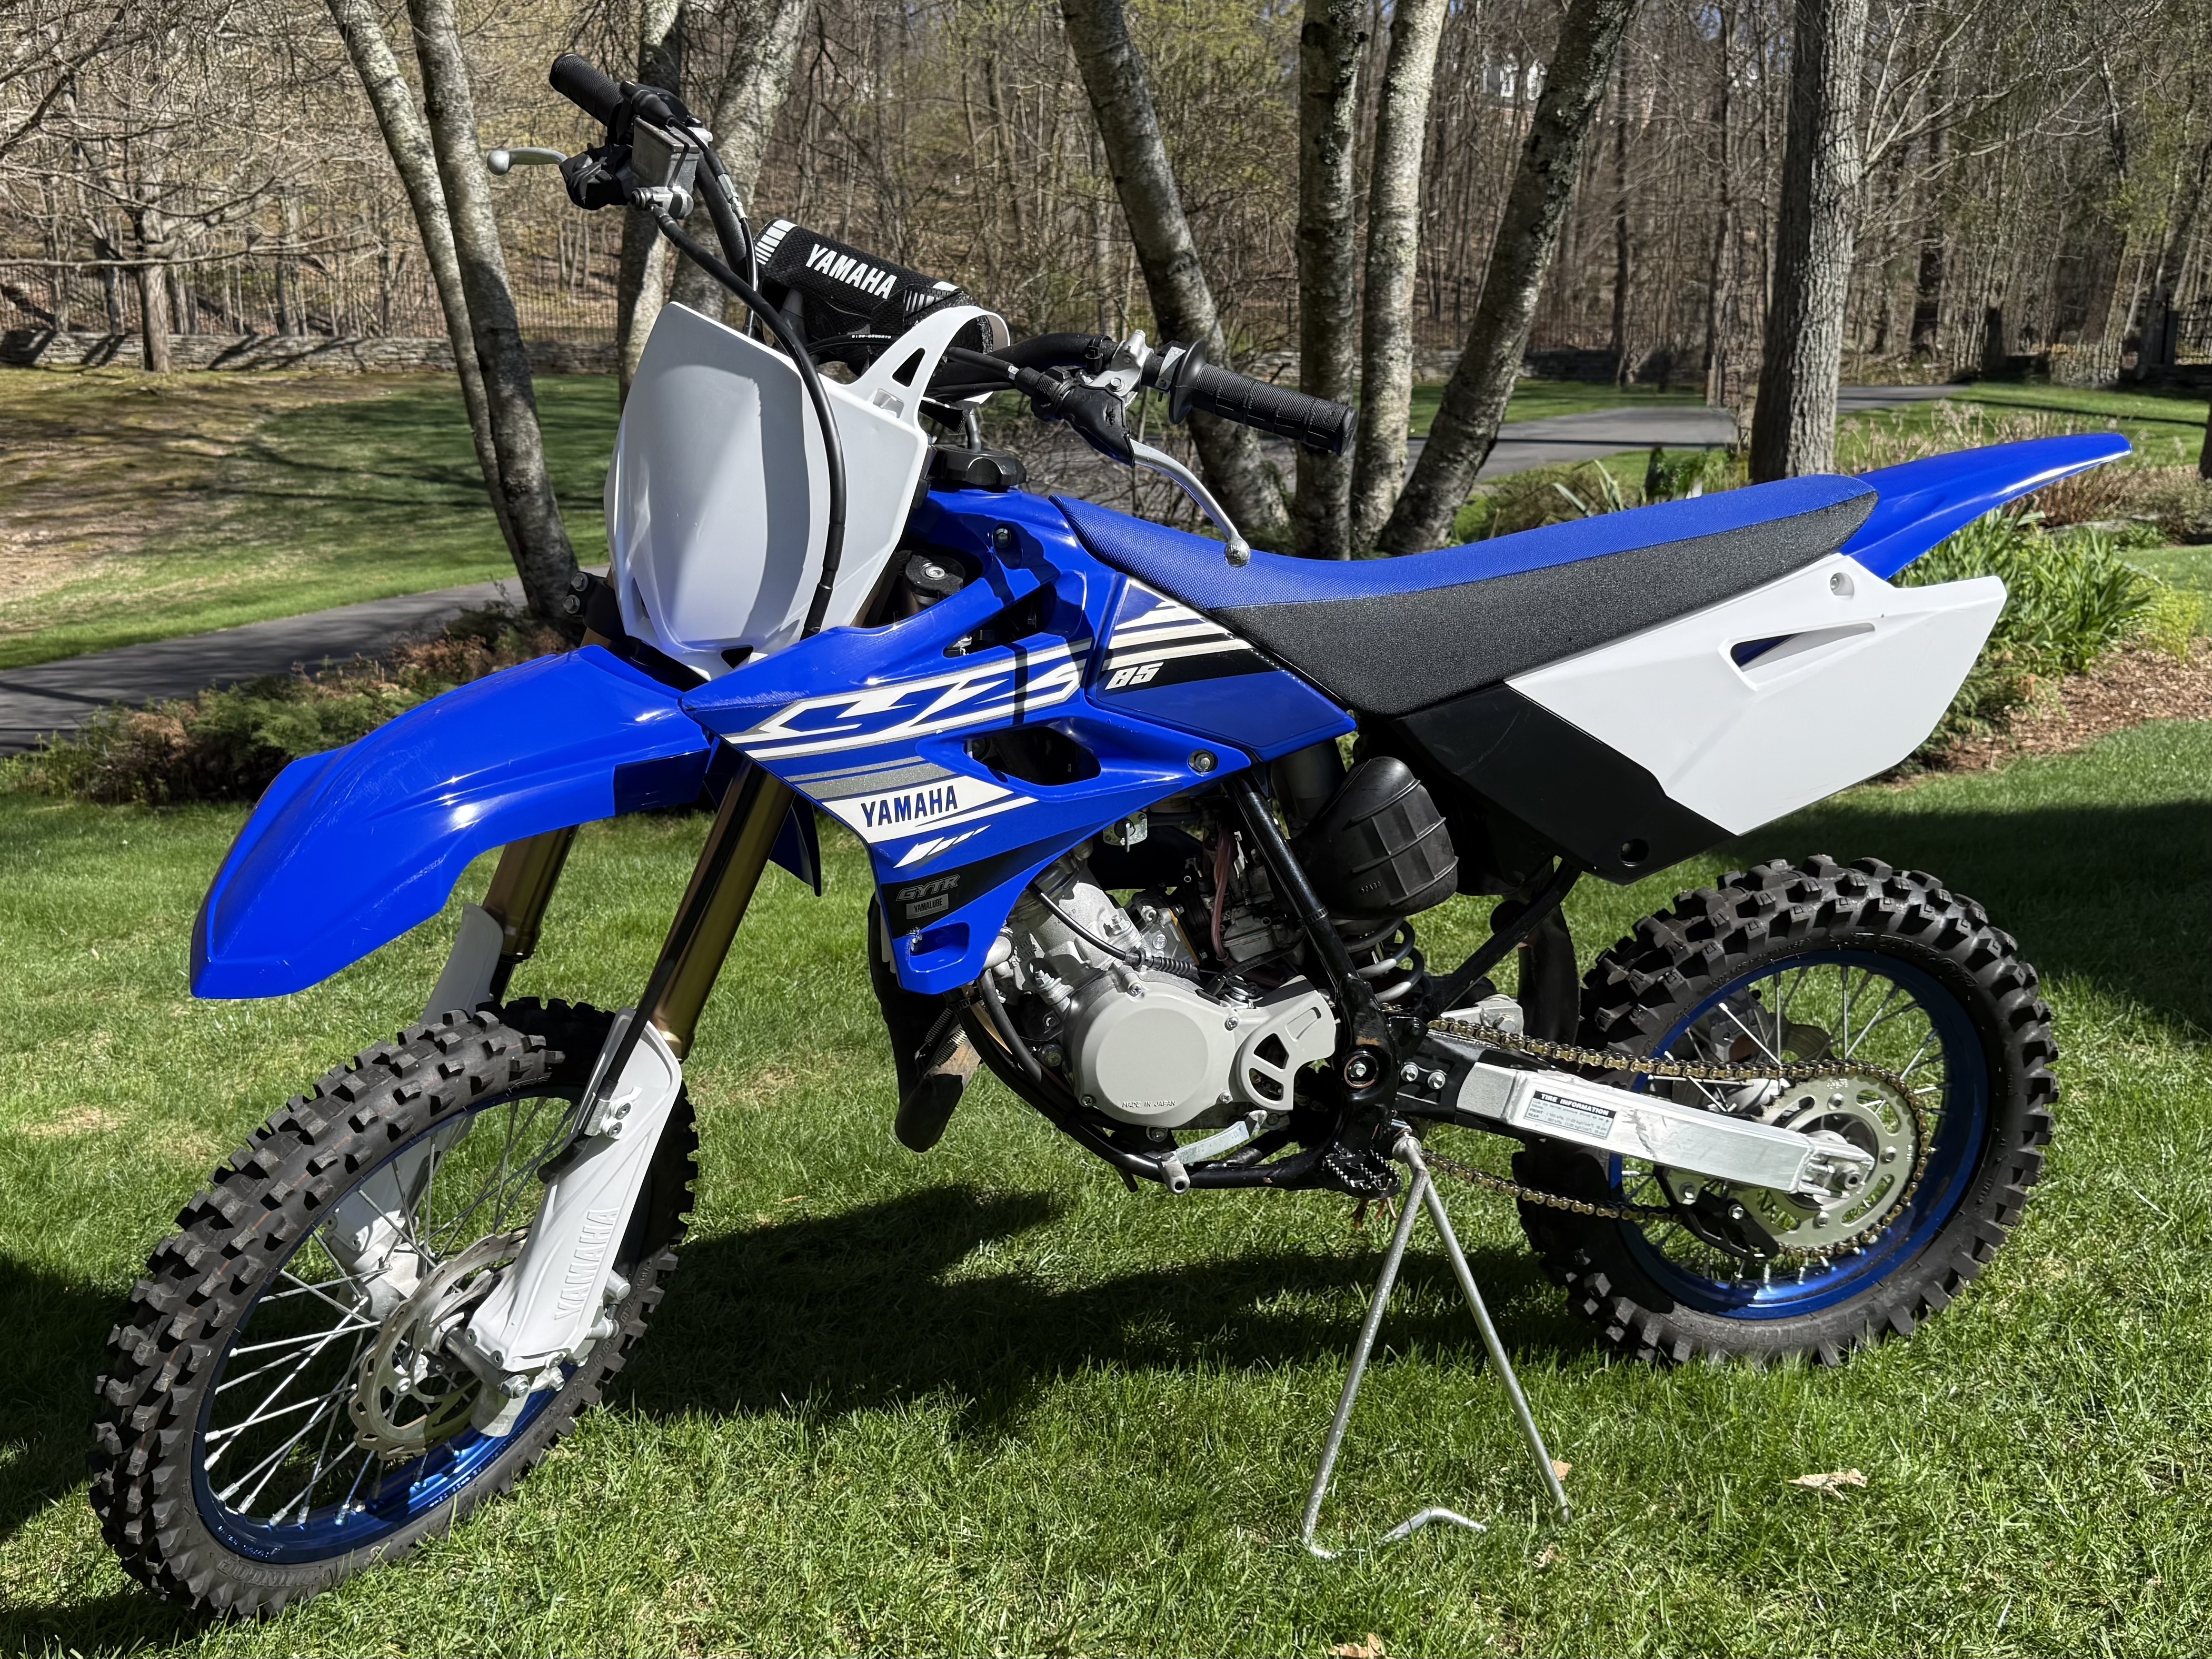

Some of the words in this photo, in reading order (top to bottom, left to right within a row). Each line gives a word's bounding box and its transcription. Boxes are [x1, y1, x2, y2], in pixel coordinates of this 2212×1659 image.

[805, 244, 897, 300] YAMAHA
[1105, 662, 1164, 690] 85
[861, 785, 958, 828] YAMAHA
[895, 874, 961, 901] GYTR
[914, 898, 943, 913] YAMALUBE
[1541, 1094, 1558, 1102] TIRE
[1560, 1098, 1609, 1116] INFORMATION
[554, 1207, 620, 1320] YAMAHA
